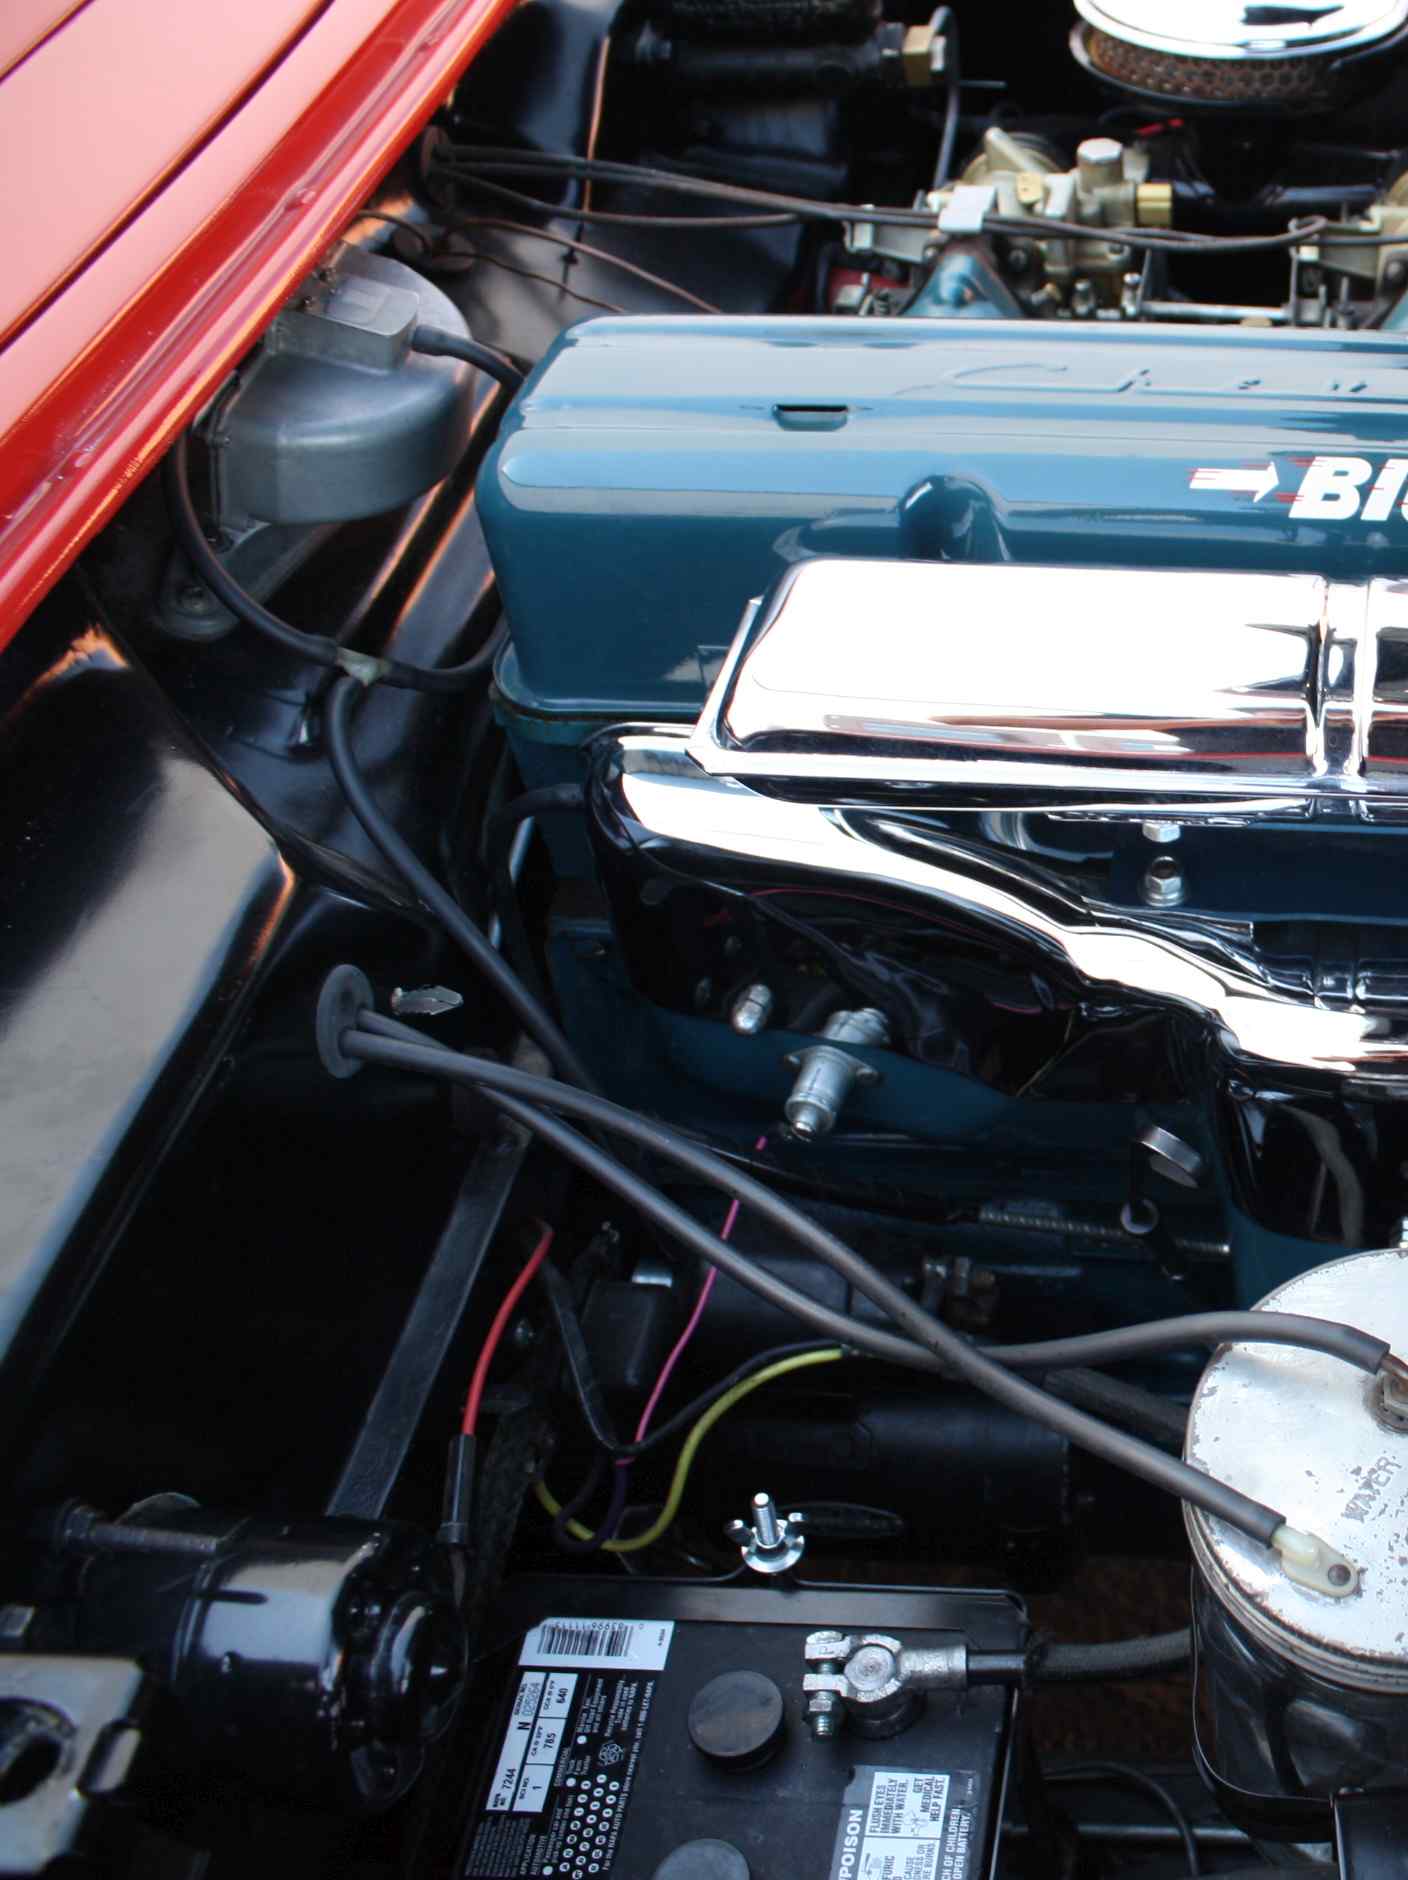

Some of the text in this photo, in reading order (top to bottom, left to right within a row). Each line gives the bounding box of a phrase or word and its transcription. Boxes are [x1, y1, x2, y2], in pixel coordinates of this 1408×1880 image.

[554, 1688, 568, 1704] 640
[516, 1722, 531, 1730] N
[542, 1734, 556, 1749] 785
[500, 1769, 516, 1790] 7244
[912, 1778, 923, 1793] GET
[919, 1777, 935, 1813] MEDICAL
[869, 1786, 885, 1833] FLUSH EYES
[877, 1778, 898, 1834] IMMEDIATELY
[891, 1780, 908, 1834] WITH WATER.
[929, 1778, 945, 1821] HELP FAST.
[839, 1809, 864, 1880] POISON
[945, 1809, 961, 1853] CHILDREN
[952, 1813, 971, 1880] OPEN BATTERY.
[944, 1855, 954, 1867] OF
